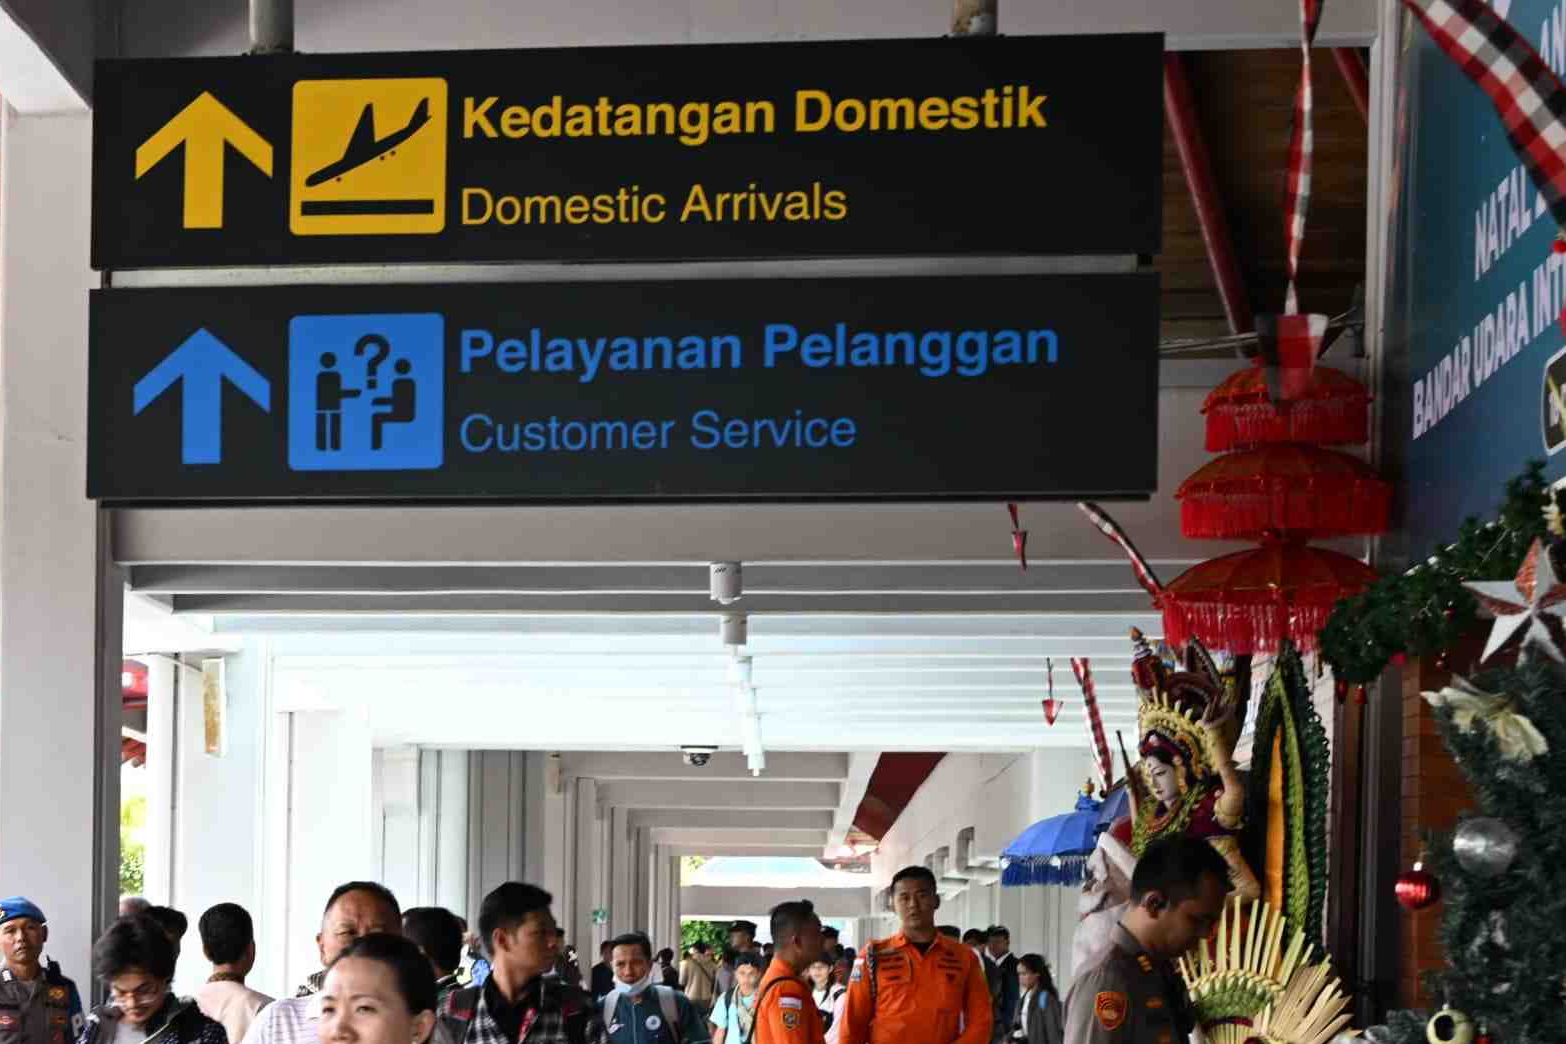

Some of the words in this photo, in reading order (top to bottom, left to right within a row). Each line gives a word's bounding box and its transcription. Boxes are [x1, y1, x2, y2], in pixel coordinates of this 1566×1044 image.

[463, 94, 775, 146] Kedatangan
[795, 85, 1047, 132] Domestik
[462, 185, 665, 225] Domestic
[680, 182, 847, 222] Arrivals
[1474, 164, 1532, 282] NATAL
[461, 328, 742, 384] Pelayanan
[764, 323, 1058, 377] Pelanggan
[1412, 334, 1471, 440] BANDAR
[1474, 281, 1530, 388] UDARA
[459, 413, 675, 453] Customer
[690, 409, 856, 449] Service
